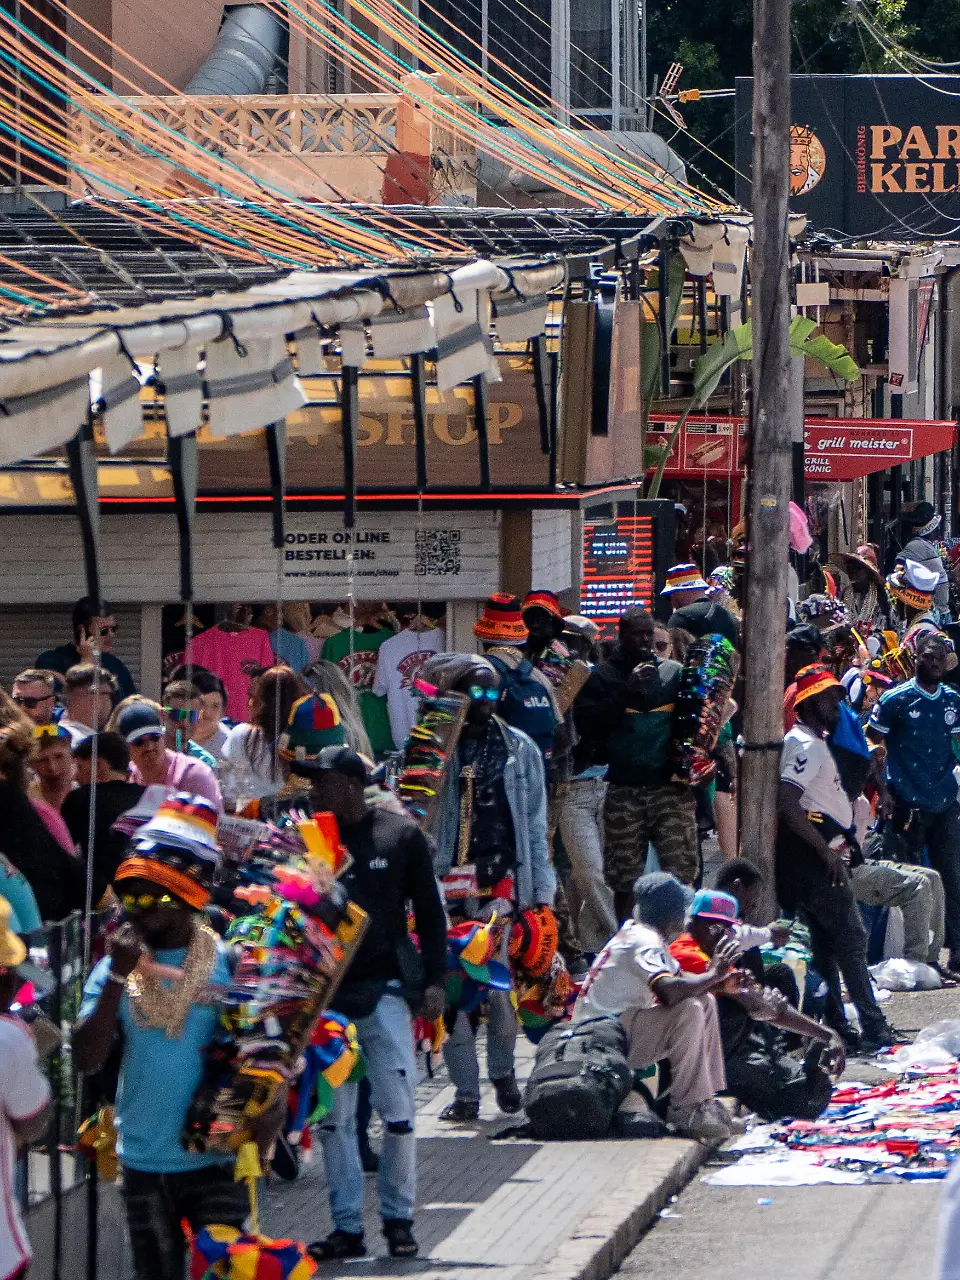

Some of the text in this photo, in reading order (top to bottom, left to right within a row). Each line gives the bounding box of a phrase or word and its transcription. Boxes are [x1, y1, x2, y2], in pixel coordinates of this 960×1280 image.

[855, 125, 866, 193] BIERKÖNIG
[817, 436, 900, 450] grill meister
[804, 457, 830, 465] GRILL
[285, 533, 328, 544] ODER
